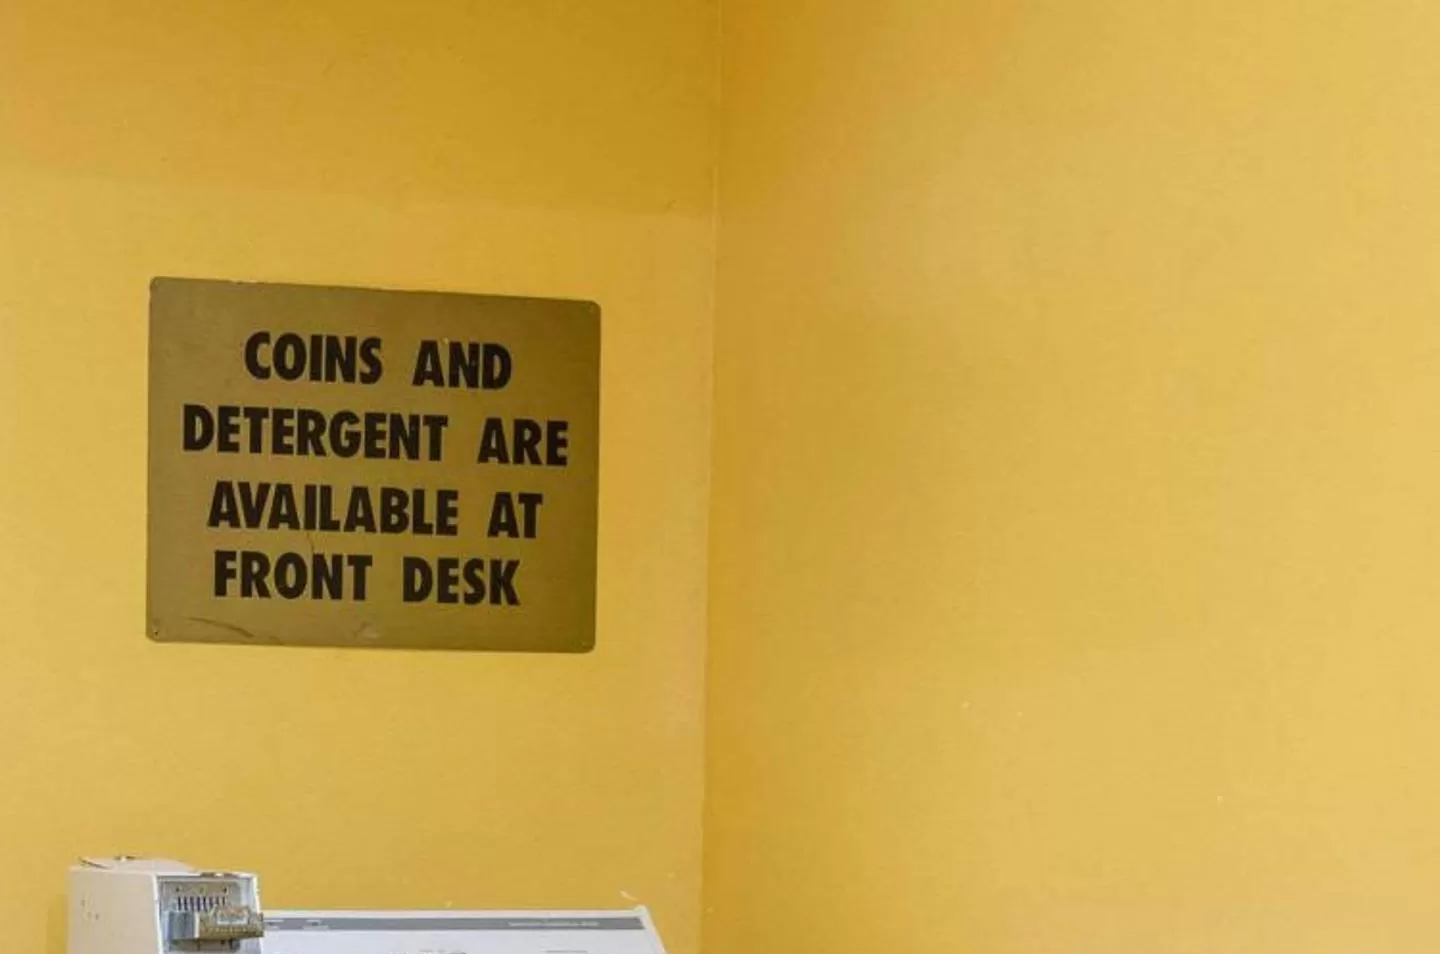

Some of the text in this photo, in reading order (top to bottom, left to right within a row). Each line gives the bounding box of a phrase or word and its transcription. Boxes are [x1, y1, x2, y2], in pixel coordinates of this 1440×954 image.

[244, 331, 512, 390] COINS AND
[183, 403, 568, 467] DETERGENT ARE
[207, 480, 544, 539] AVAILABLE AT
[214, 550, 521, 606] FRONT DESK
